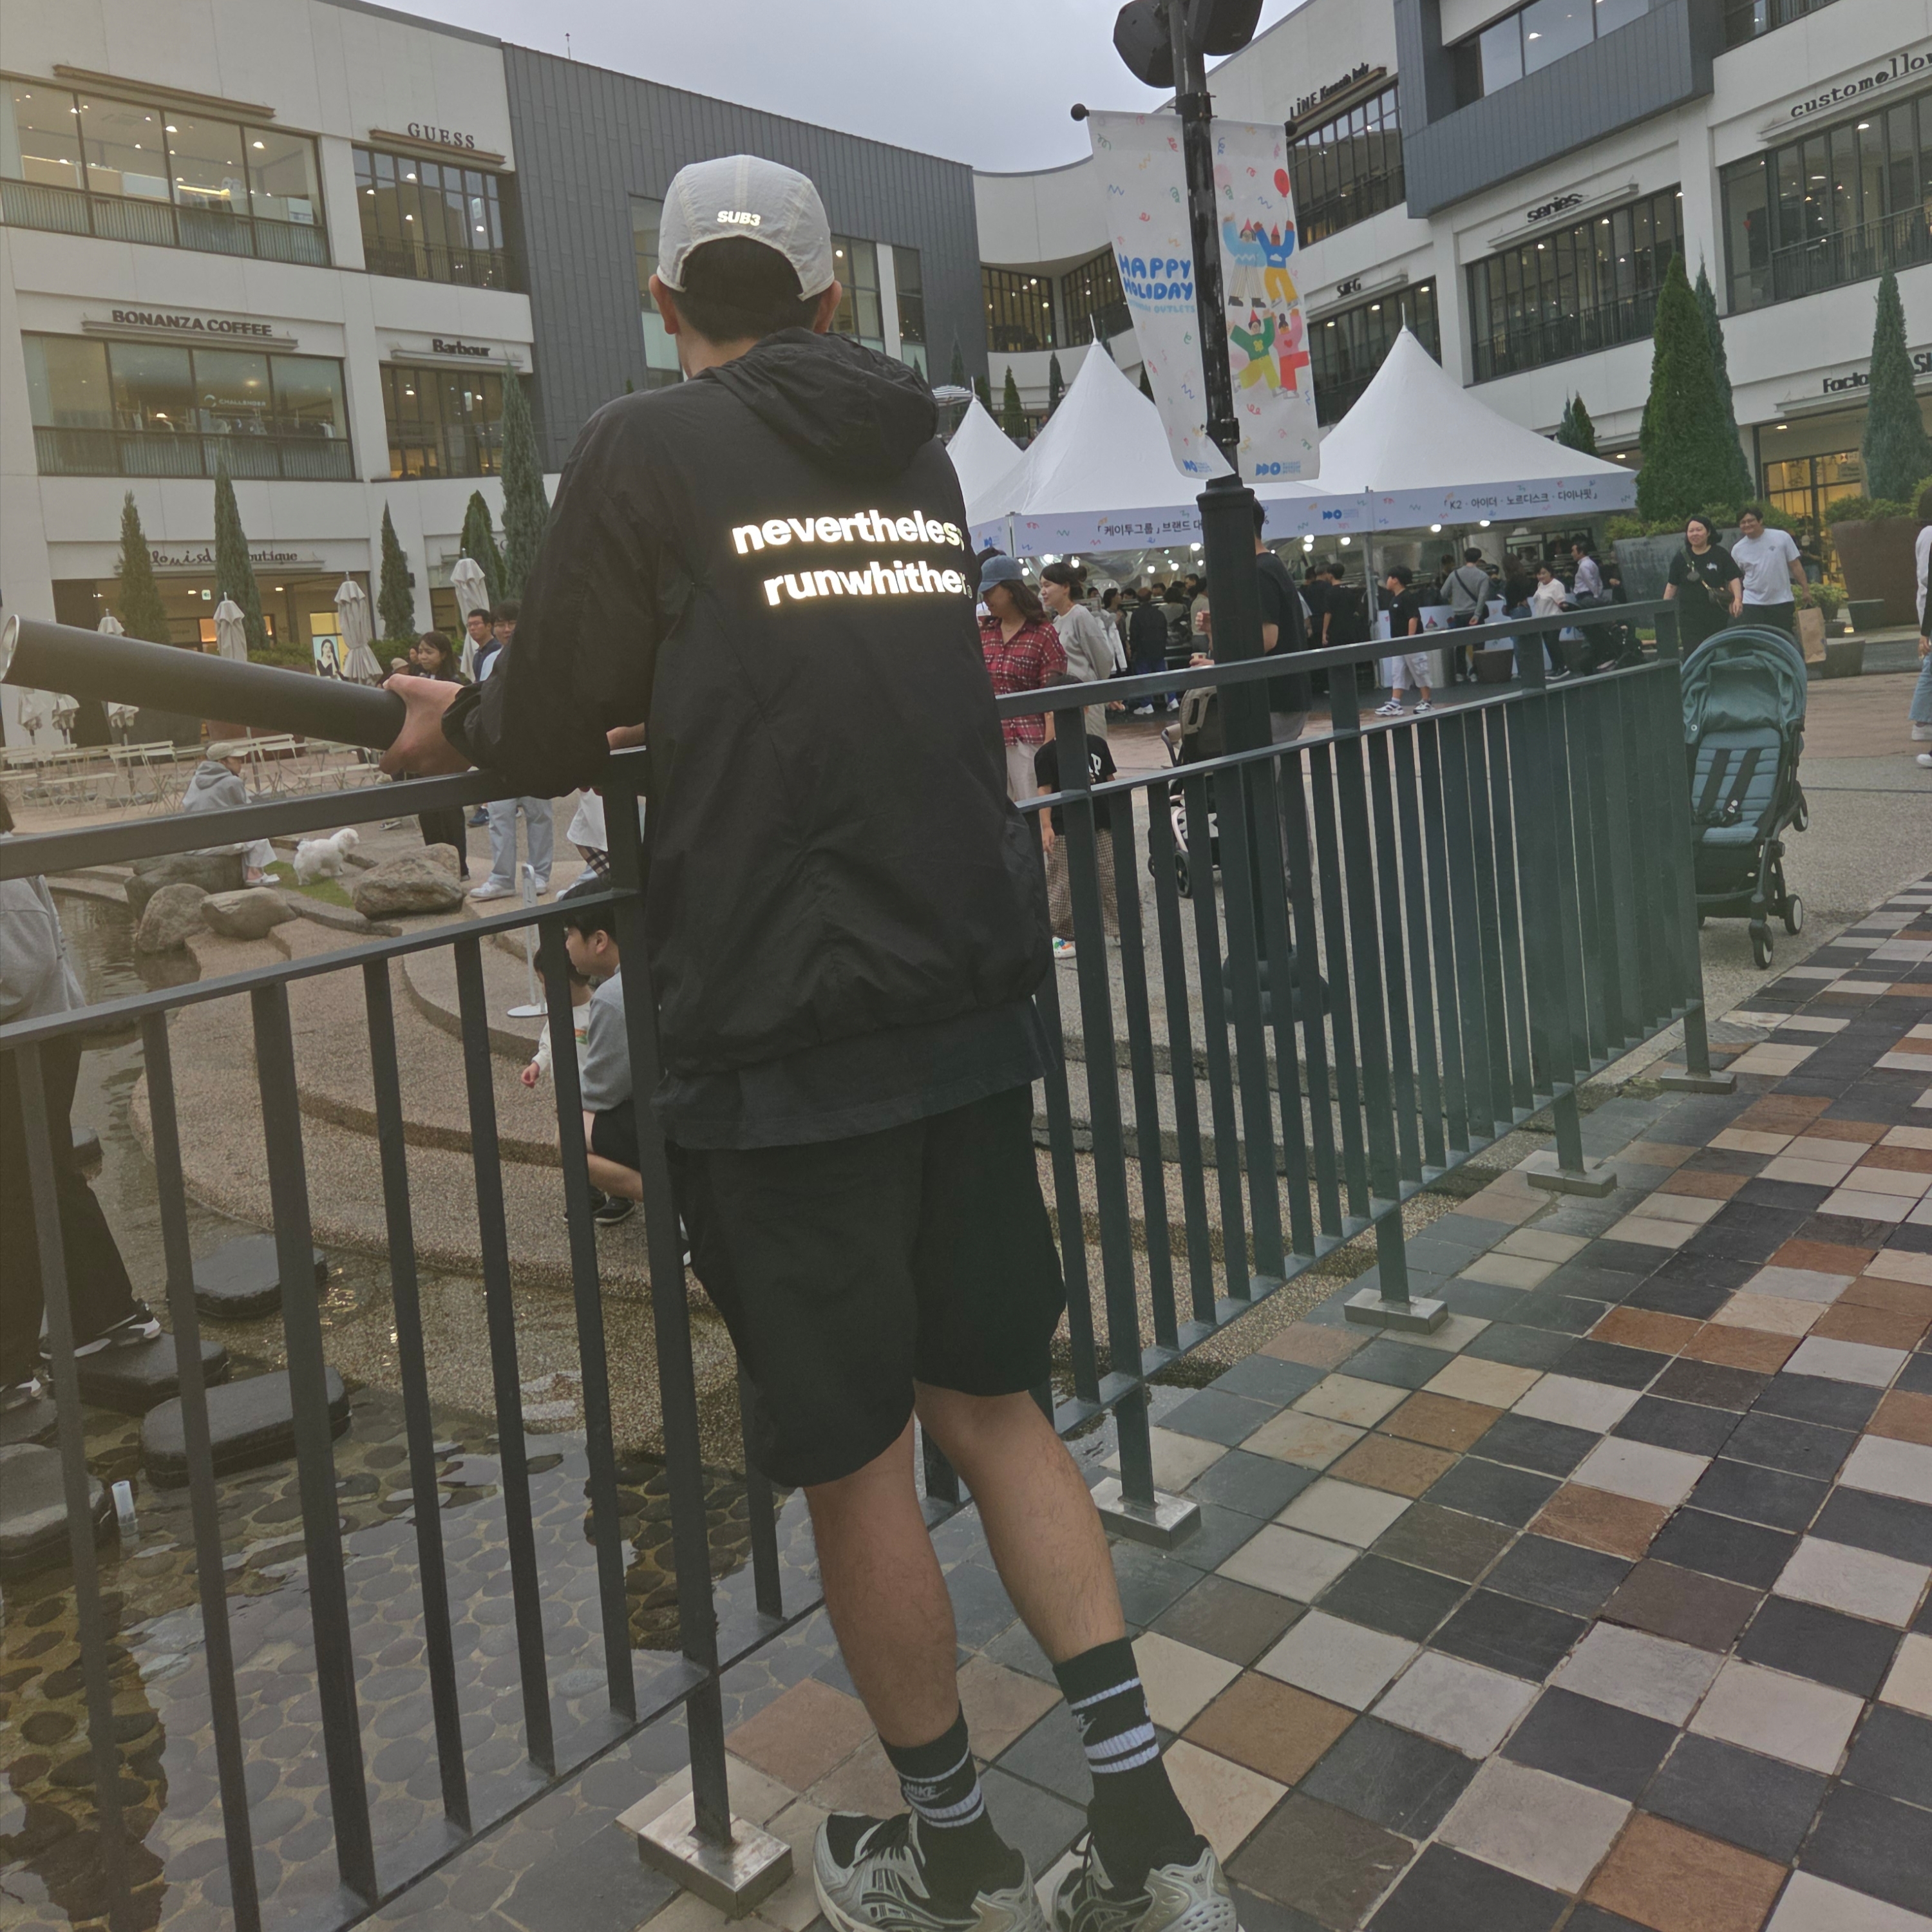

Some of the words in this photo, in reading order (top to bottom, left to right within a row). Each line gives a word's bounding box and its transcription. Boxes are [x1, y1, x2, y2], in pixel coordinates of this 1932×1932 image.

[407, 122, 475, 149] GUESS
[1527, 193, 1583, 223] series
[717, 211, 761, 227] SUB3
[1118, 252, 1191, 279] HAPPY
[1122, 276, 1193, 301] HOLIDAY
[112, 310, 205, 330] BONANZA
[207, 319, 272, 337] COFFEE
[432, 339, 491, 357] Barbour
[1823, 372, 1869, 393] Facto
[1471, 497, 1497, 509] 아이더
[1506, 493, 1549, 506] 노르디스크
[1162, 520, 1191, 533] 브랜드
[249, 550, 298, 565] outique
